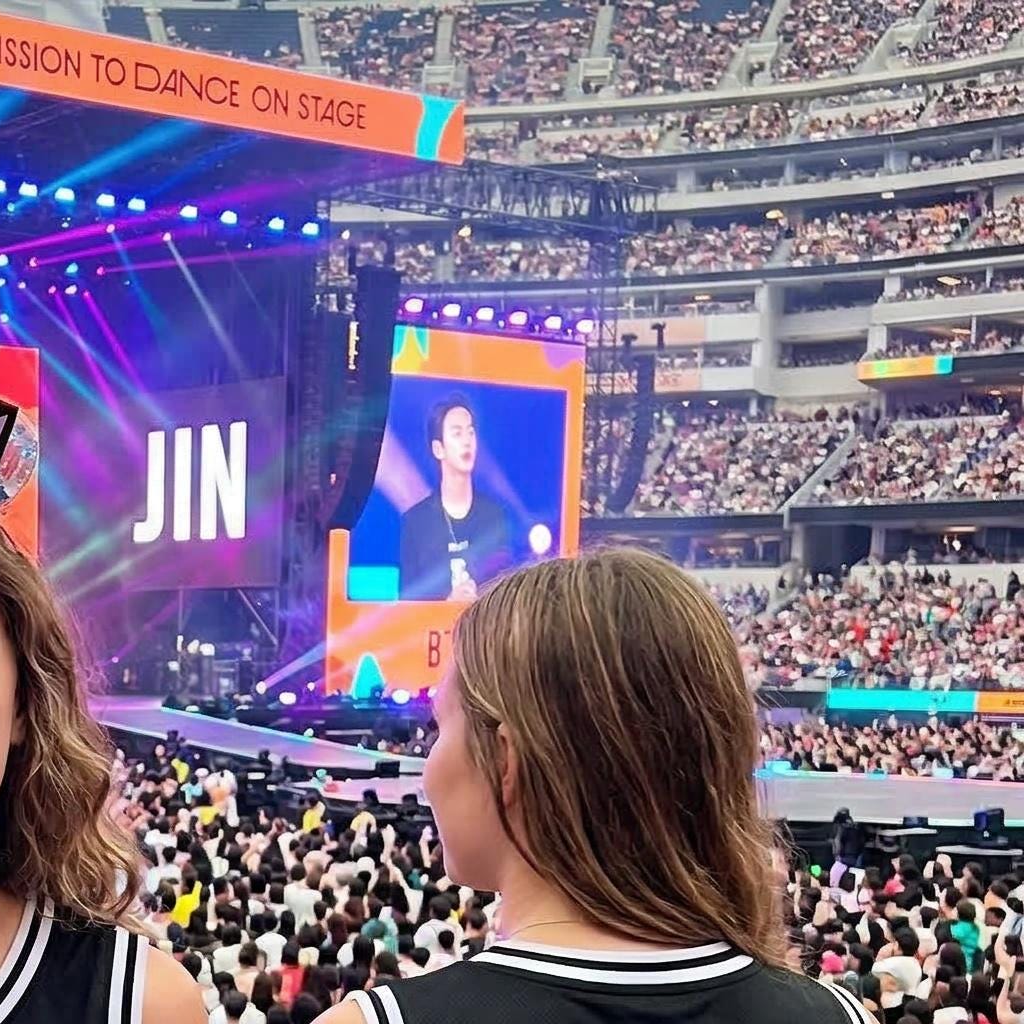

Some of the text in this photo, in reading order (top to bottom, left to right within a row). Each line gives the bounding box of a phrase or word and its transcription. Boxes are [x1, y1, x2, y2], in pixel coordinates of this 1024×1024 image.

[90, 53, 126, 86] TO
[134, 62, 240, 108] DANCE
[251, 85, 289, 116] ON
[297, 93, 367, 130] STAGE
[132, 420, 248, 544] JIN
